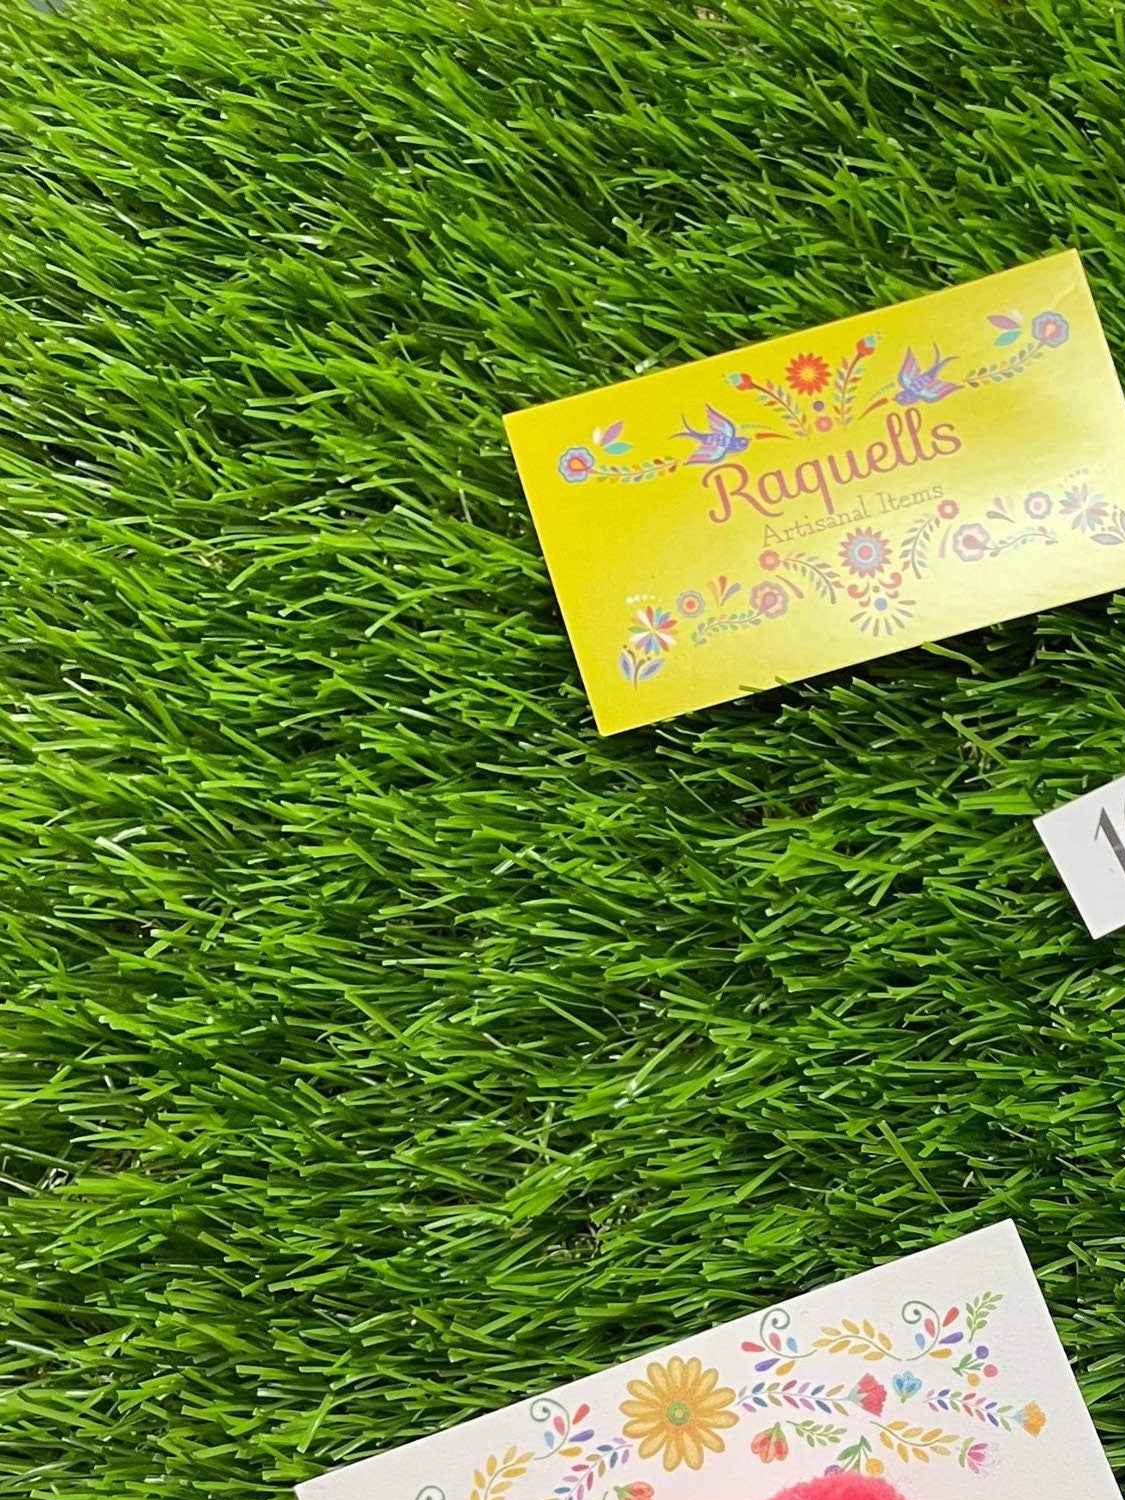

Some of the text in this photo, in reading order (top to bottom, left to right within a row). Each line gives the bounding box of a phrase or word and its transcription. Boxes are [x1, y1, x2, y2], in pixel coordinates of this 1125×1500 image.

[701, 407, 962, 524] Raquells
[762, 483, 945, 548] Artisanal Items
